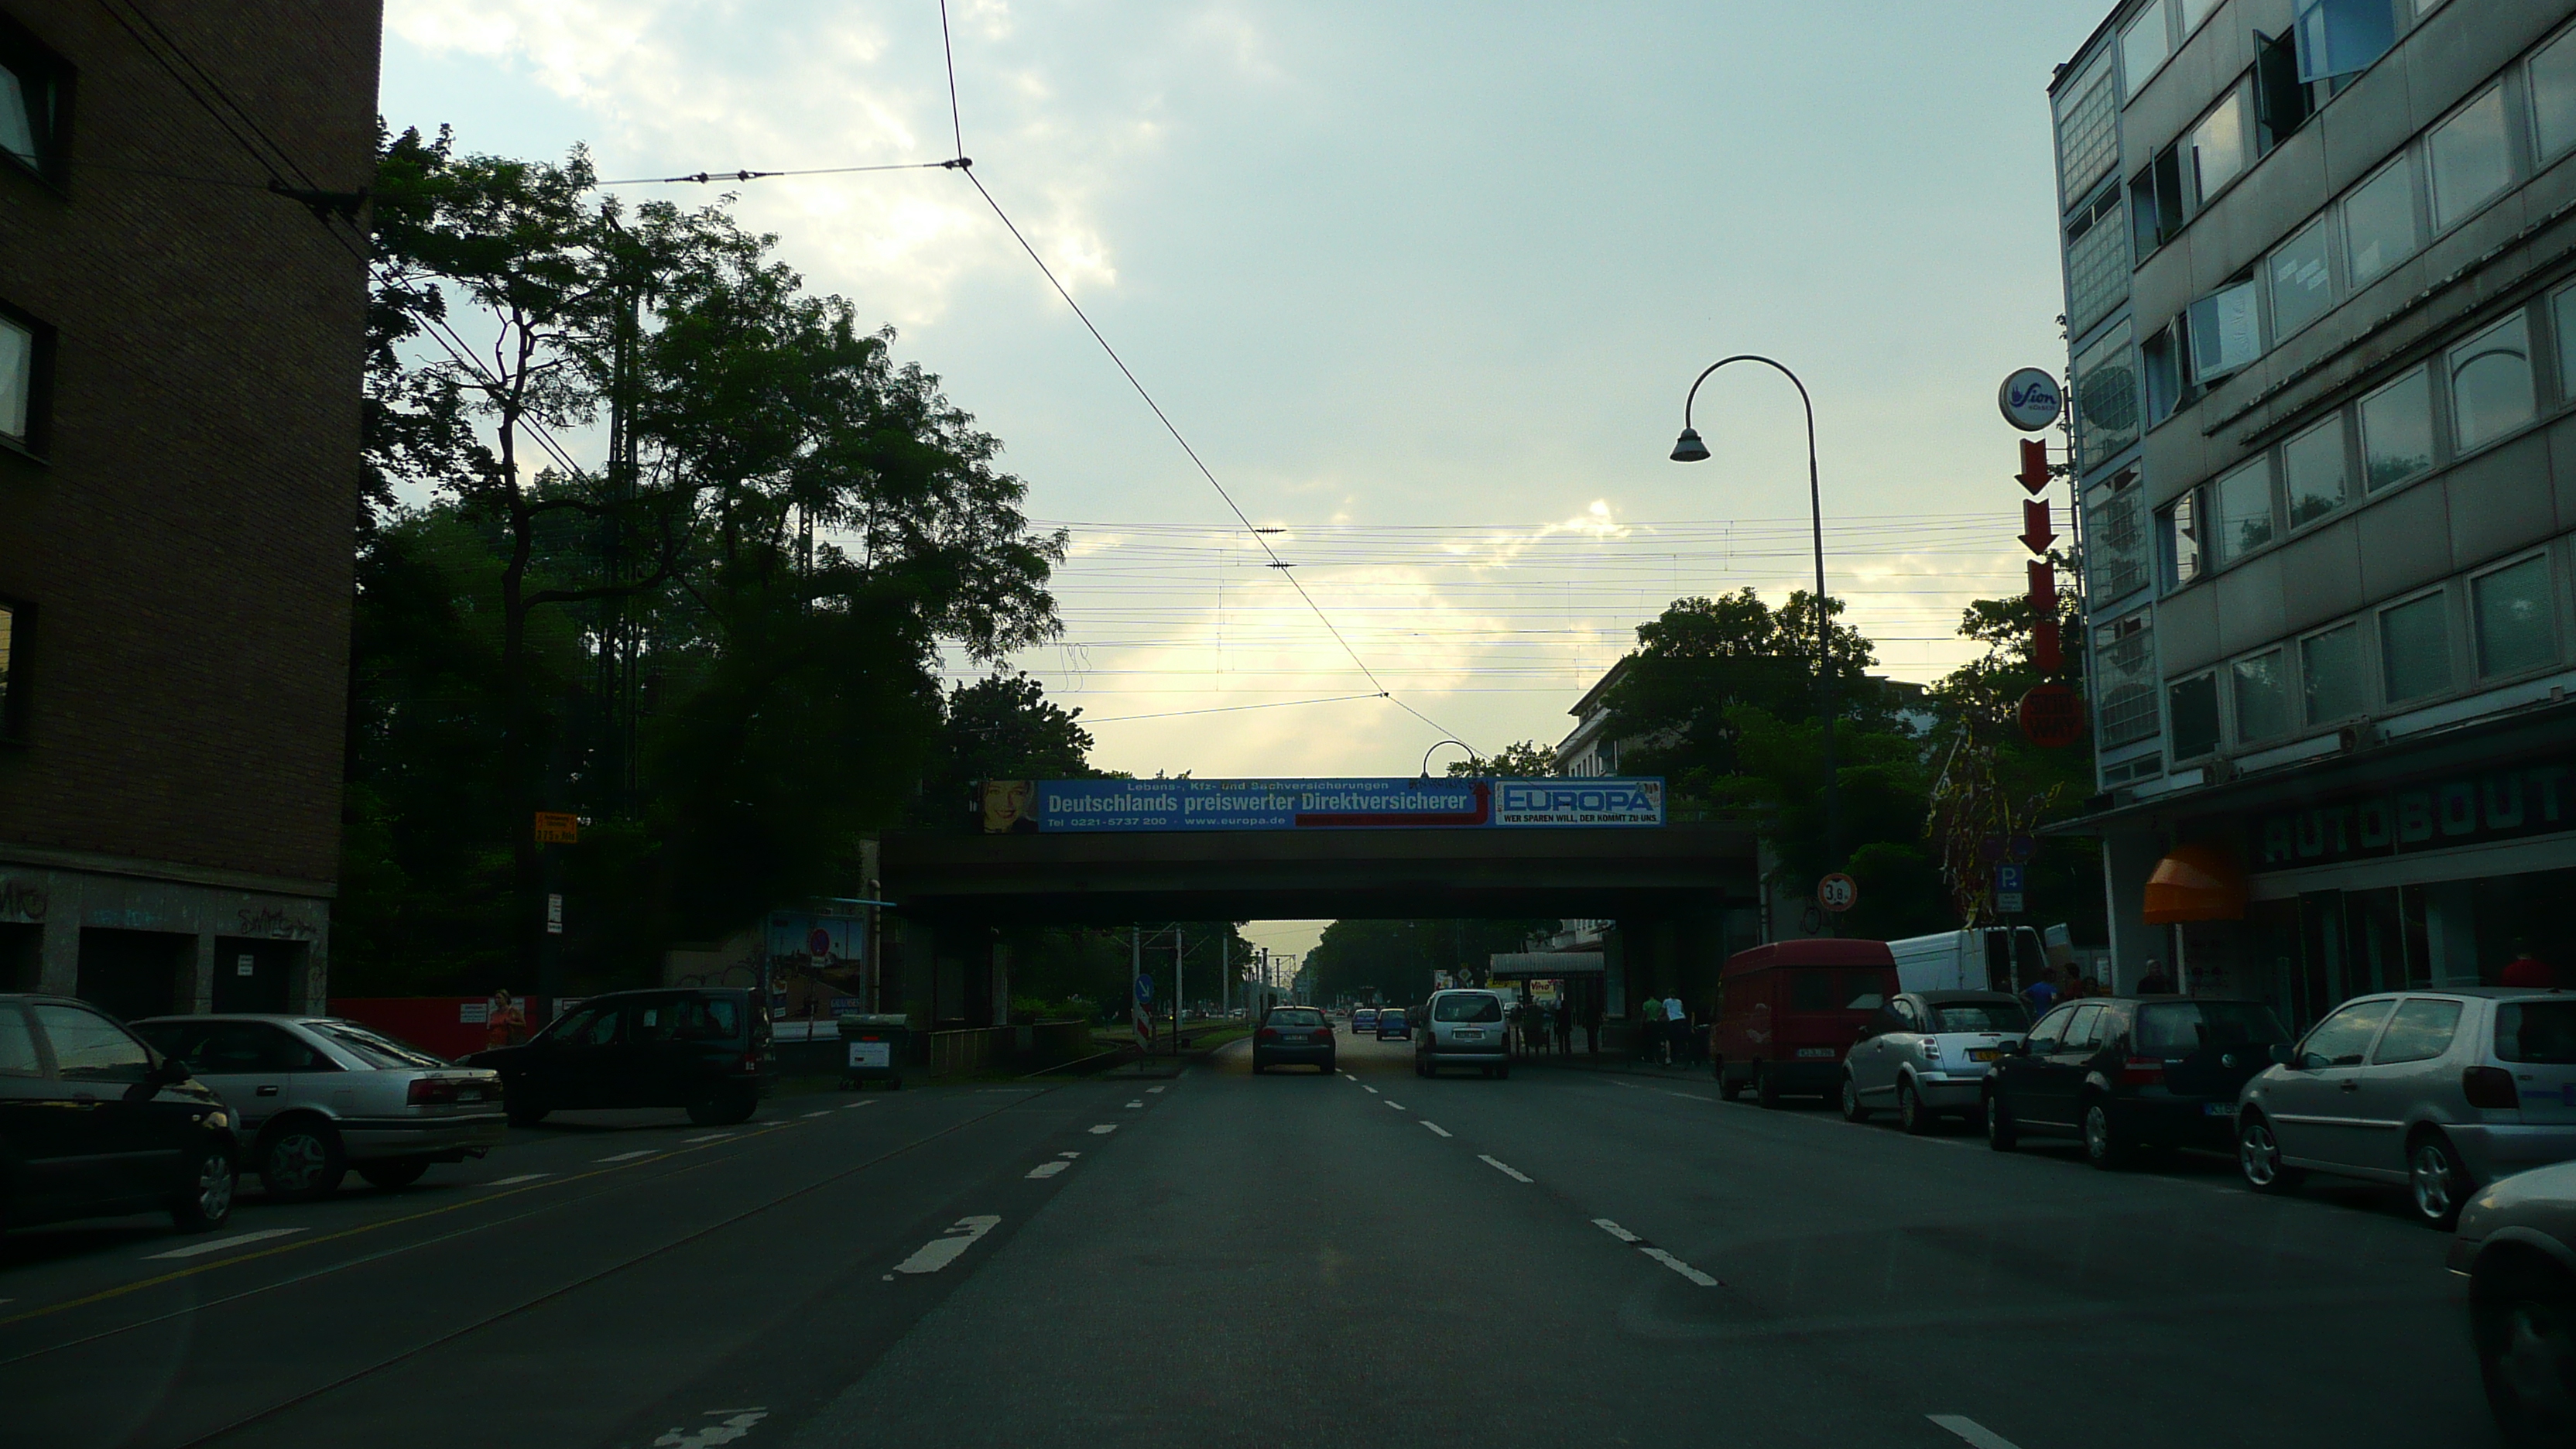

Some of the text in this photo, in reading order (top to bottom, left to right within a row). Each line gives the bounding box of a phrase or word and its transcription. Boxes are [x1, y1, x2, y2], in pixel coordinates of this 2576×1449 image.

[2009, 382, 2057, 408] Sion
[1190, 782, 1217, 790] Kfz-
[1221, 782, 1246, 790] und
[1251, 781, 1389, 791] Sachversicherungen
[1049, 791, 1468, 814] Deutschlands preiswerter Direktversicherer
[1504, 785, 1654, 811] EUROPA
[1047, 817, 1286, 827] Tel 0221-5737 200 www.europa.de
[1556, 814, 1577, 823] WILL,
[2002, 868, 2016, 888] P
